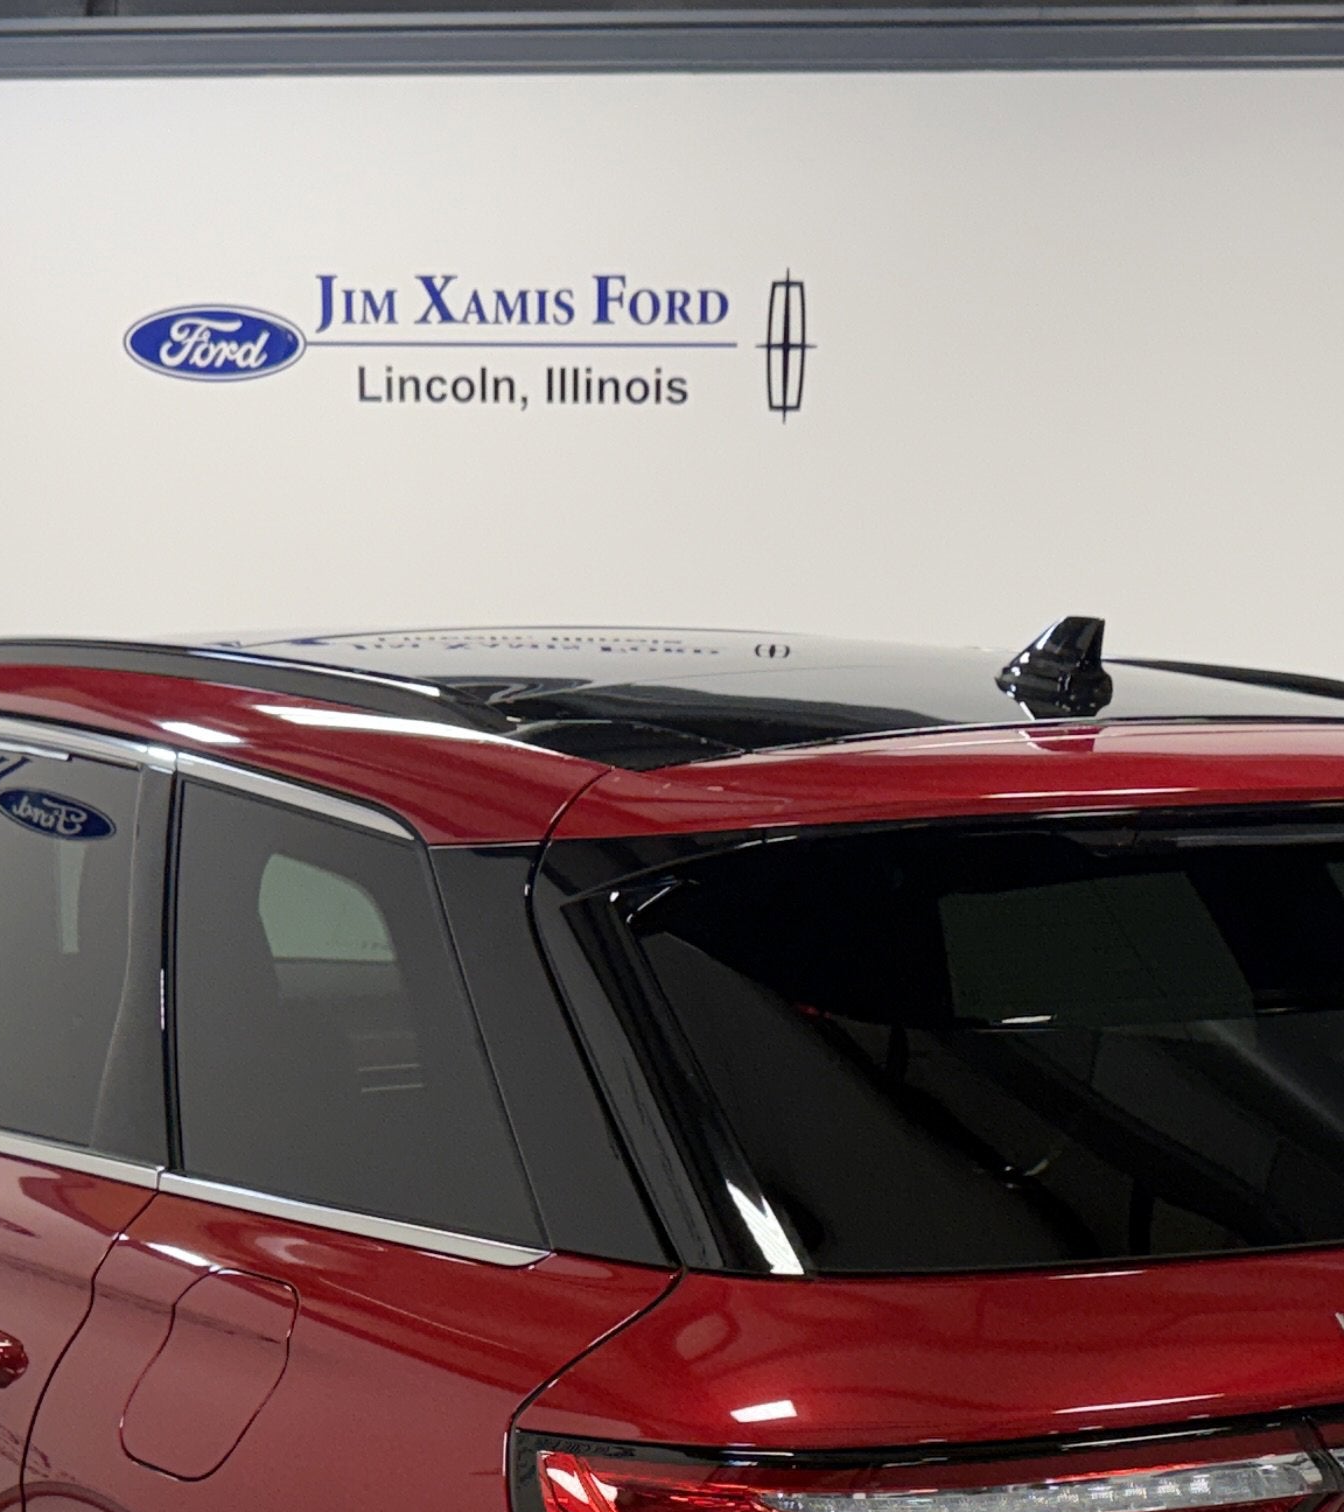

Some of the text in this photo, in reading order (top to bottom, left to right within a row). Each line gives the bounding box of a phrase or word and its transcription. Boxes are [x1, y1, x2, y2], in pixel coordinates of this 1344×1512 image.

[314, 274, 730, 334] JIM XAMIS FORD
[158, 316, 268, 369] Ford
[357, 366, 689, 410] Lincoln, Illinois
